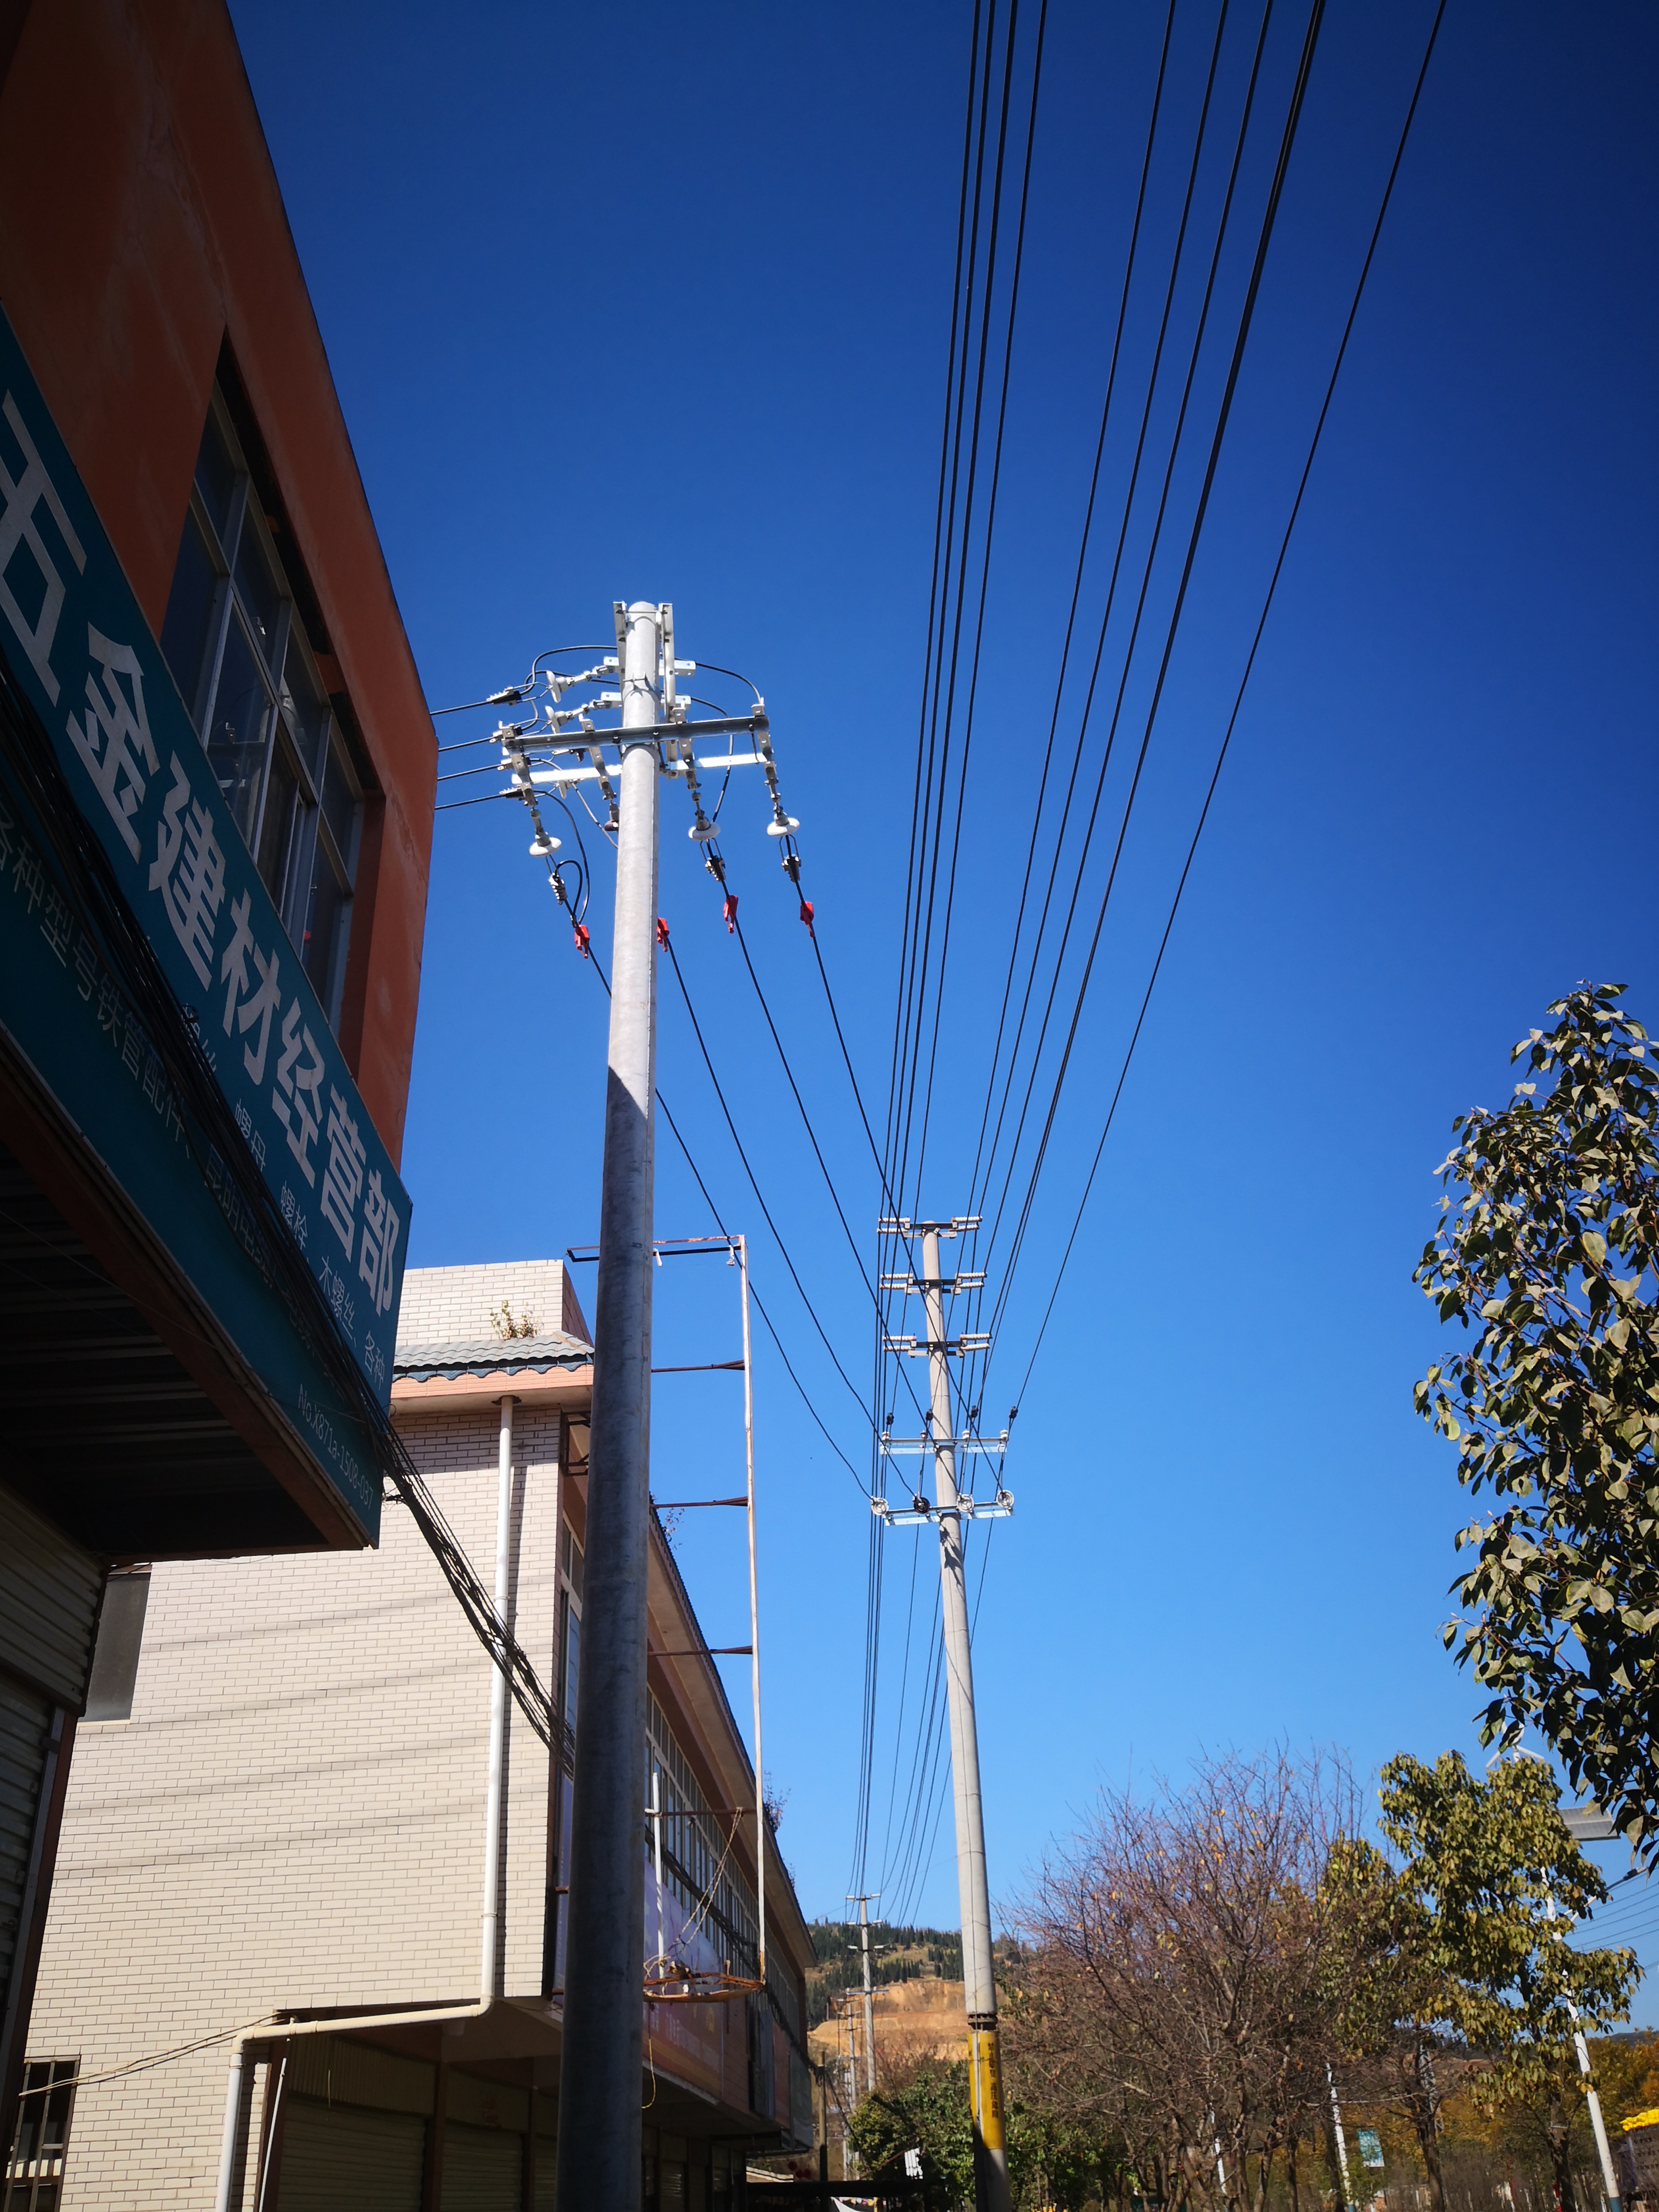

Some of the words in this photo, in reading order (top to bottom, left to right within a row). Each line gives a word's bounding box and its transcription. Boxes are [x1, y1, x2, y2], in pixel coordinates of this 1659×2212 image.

[0, 388, 400, 1317] 五金建材经营部
[298, 1382, 374, 1510] No.X871a-1508-037
